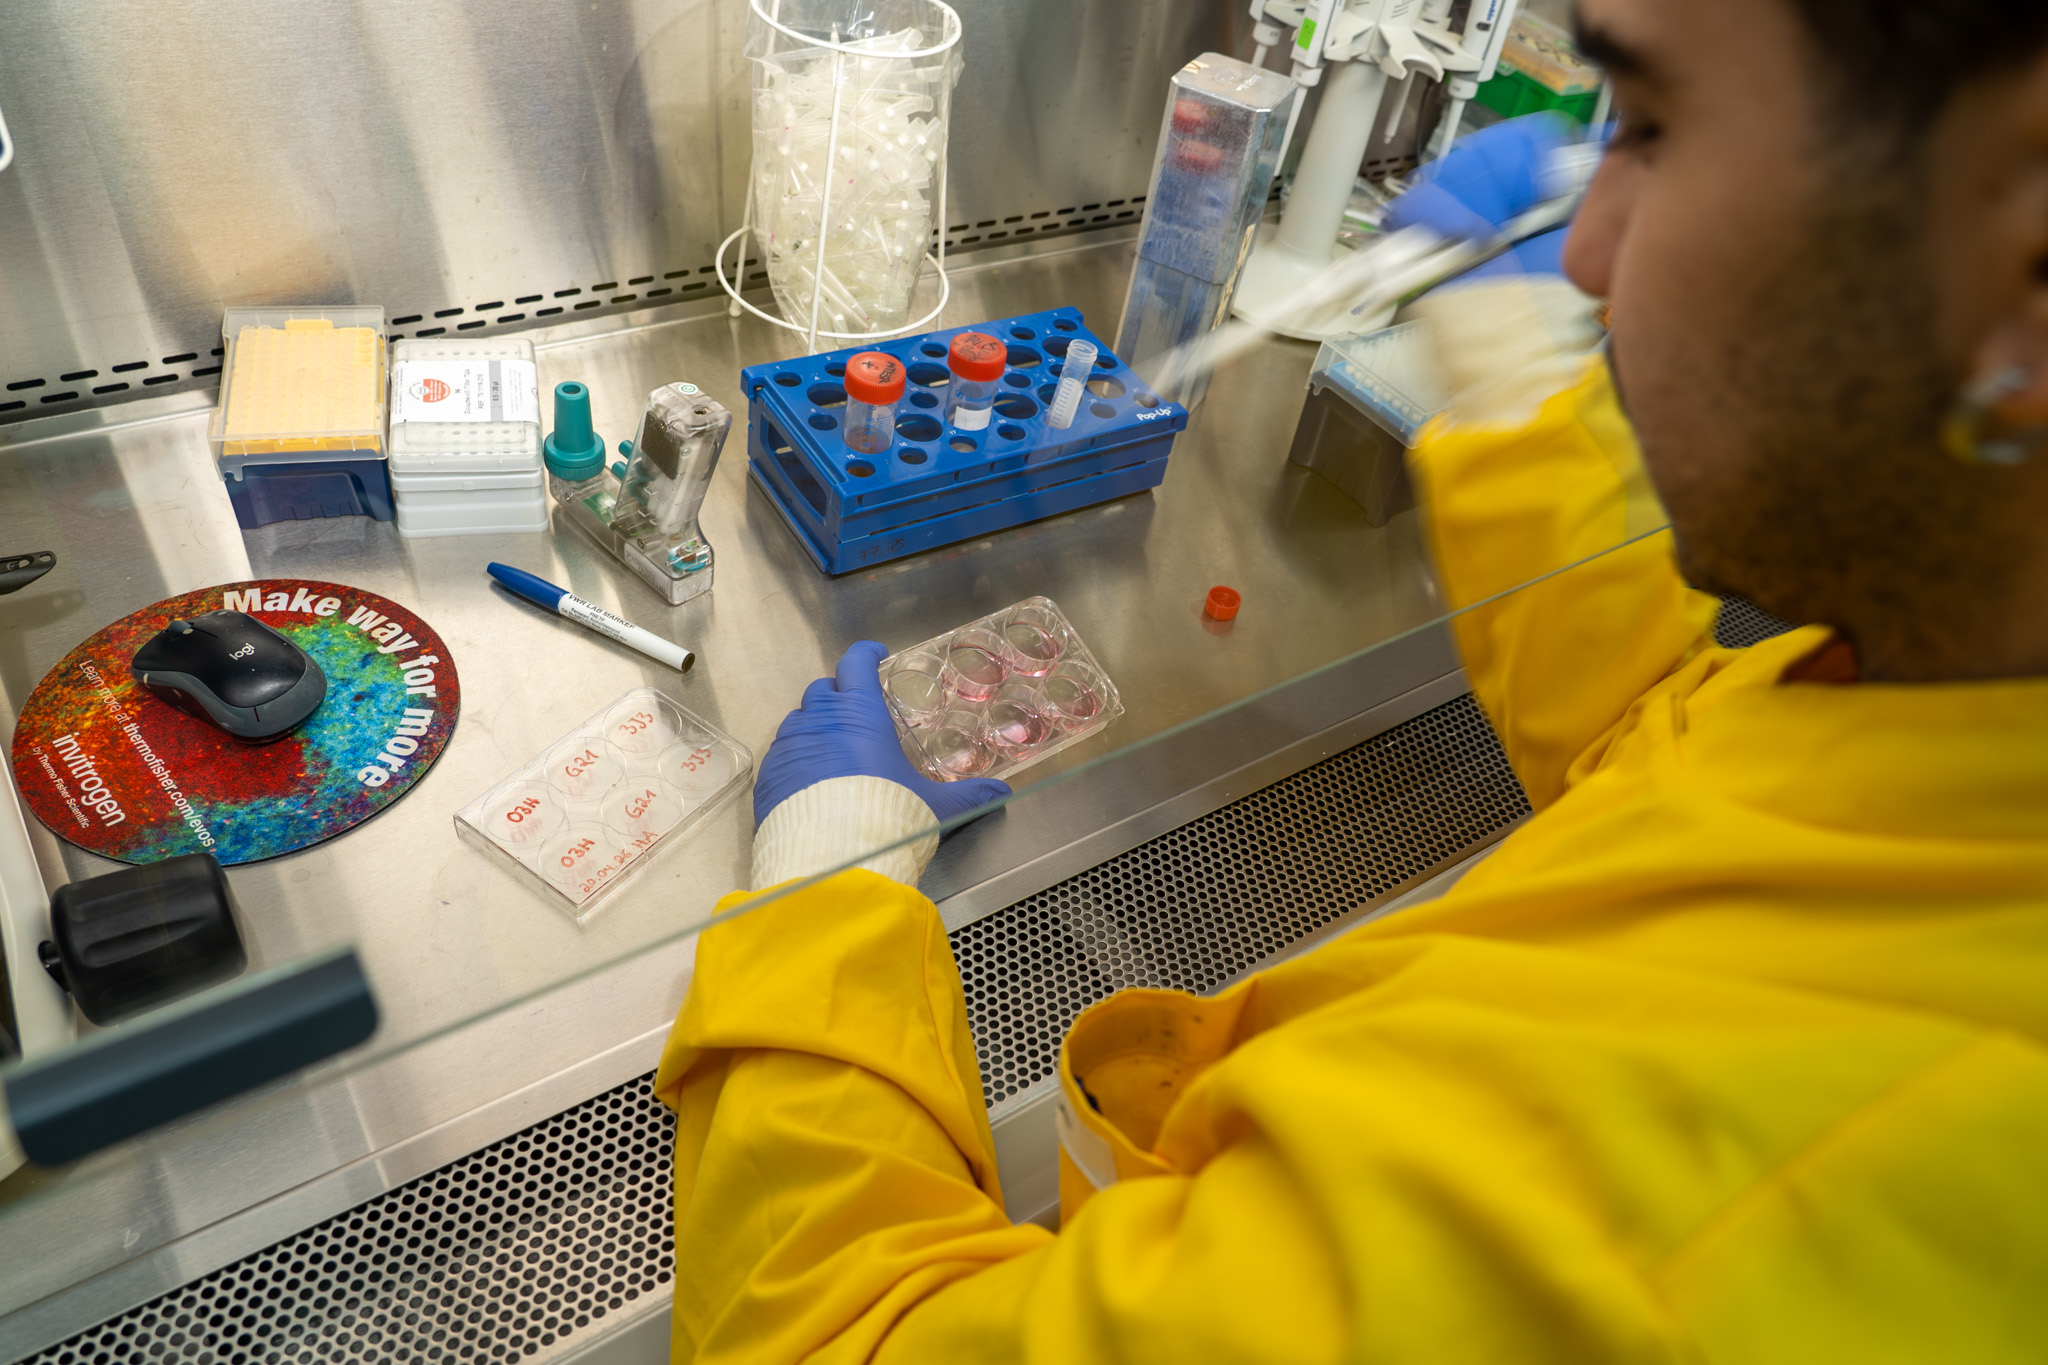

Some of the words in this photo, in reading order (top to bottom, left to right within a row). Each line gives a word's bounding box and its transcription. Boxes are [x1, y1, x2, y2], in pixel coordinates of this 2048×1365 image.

[223, 588, 342, 616] Make
[568, 594, 587, 606] VWR
[586, 603, 602, 614] LAB
[346, 605, 419, 654] way
[229, 642, 255, 661] logi
[78, 659, 105, 688] Learn
[399, 654, 439, 698] for
[98, 686, 122, 713] more
[114, 711, 133, 725] at
[357, 707, 435, 787] more
[32, 746, 43, 756] by
[38, 753, 58, 780] Thermo
[53, 777, 71, 800] Fisher
[66, 797, 90, 829] Scientific
[52, 731, 126, 827] invitrogen
[123, 722, 216, 848] thermofisher.com/evos
